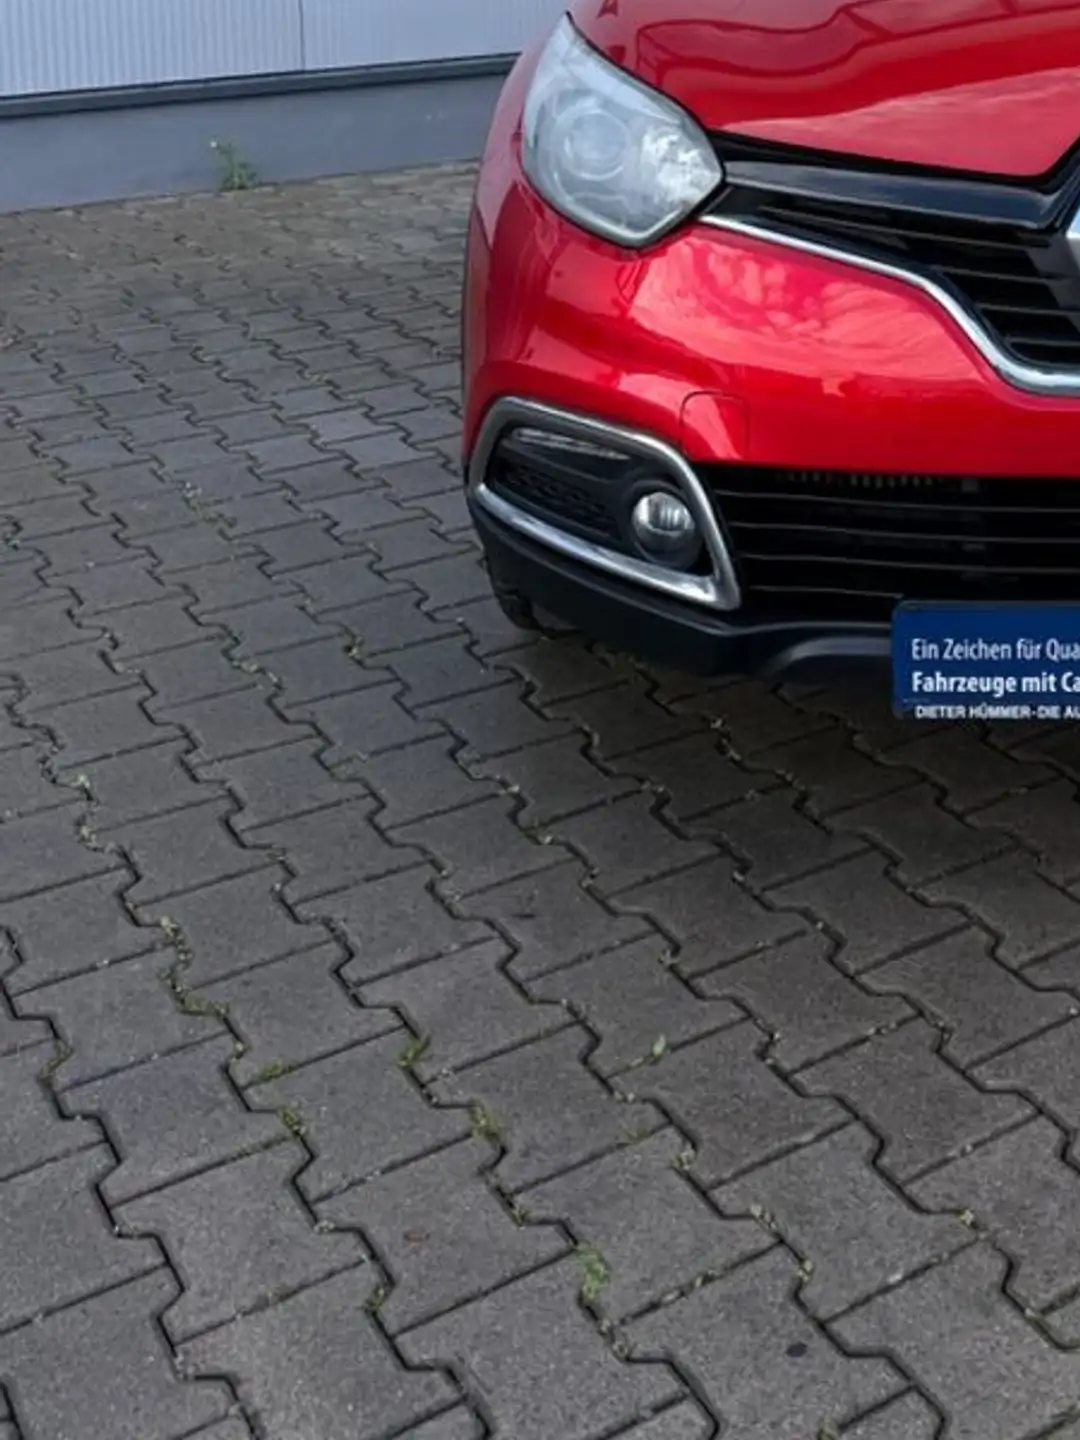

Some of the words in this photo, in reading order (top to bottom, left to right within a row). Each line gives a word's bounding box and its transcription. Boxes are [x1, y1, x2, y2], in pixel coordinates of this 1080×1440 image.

[911, 637, 940, 661] Ein
[942, 637, 1012, 661] Zeichen
[1016, 637, 1042, 661] für
[911, 671, 1017, 699] Fahrzeuge
[1021, 671, 1057, 693] mit
[915, 705, 966, 719] DIETER
